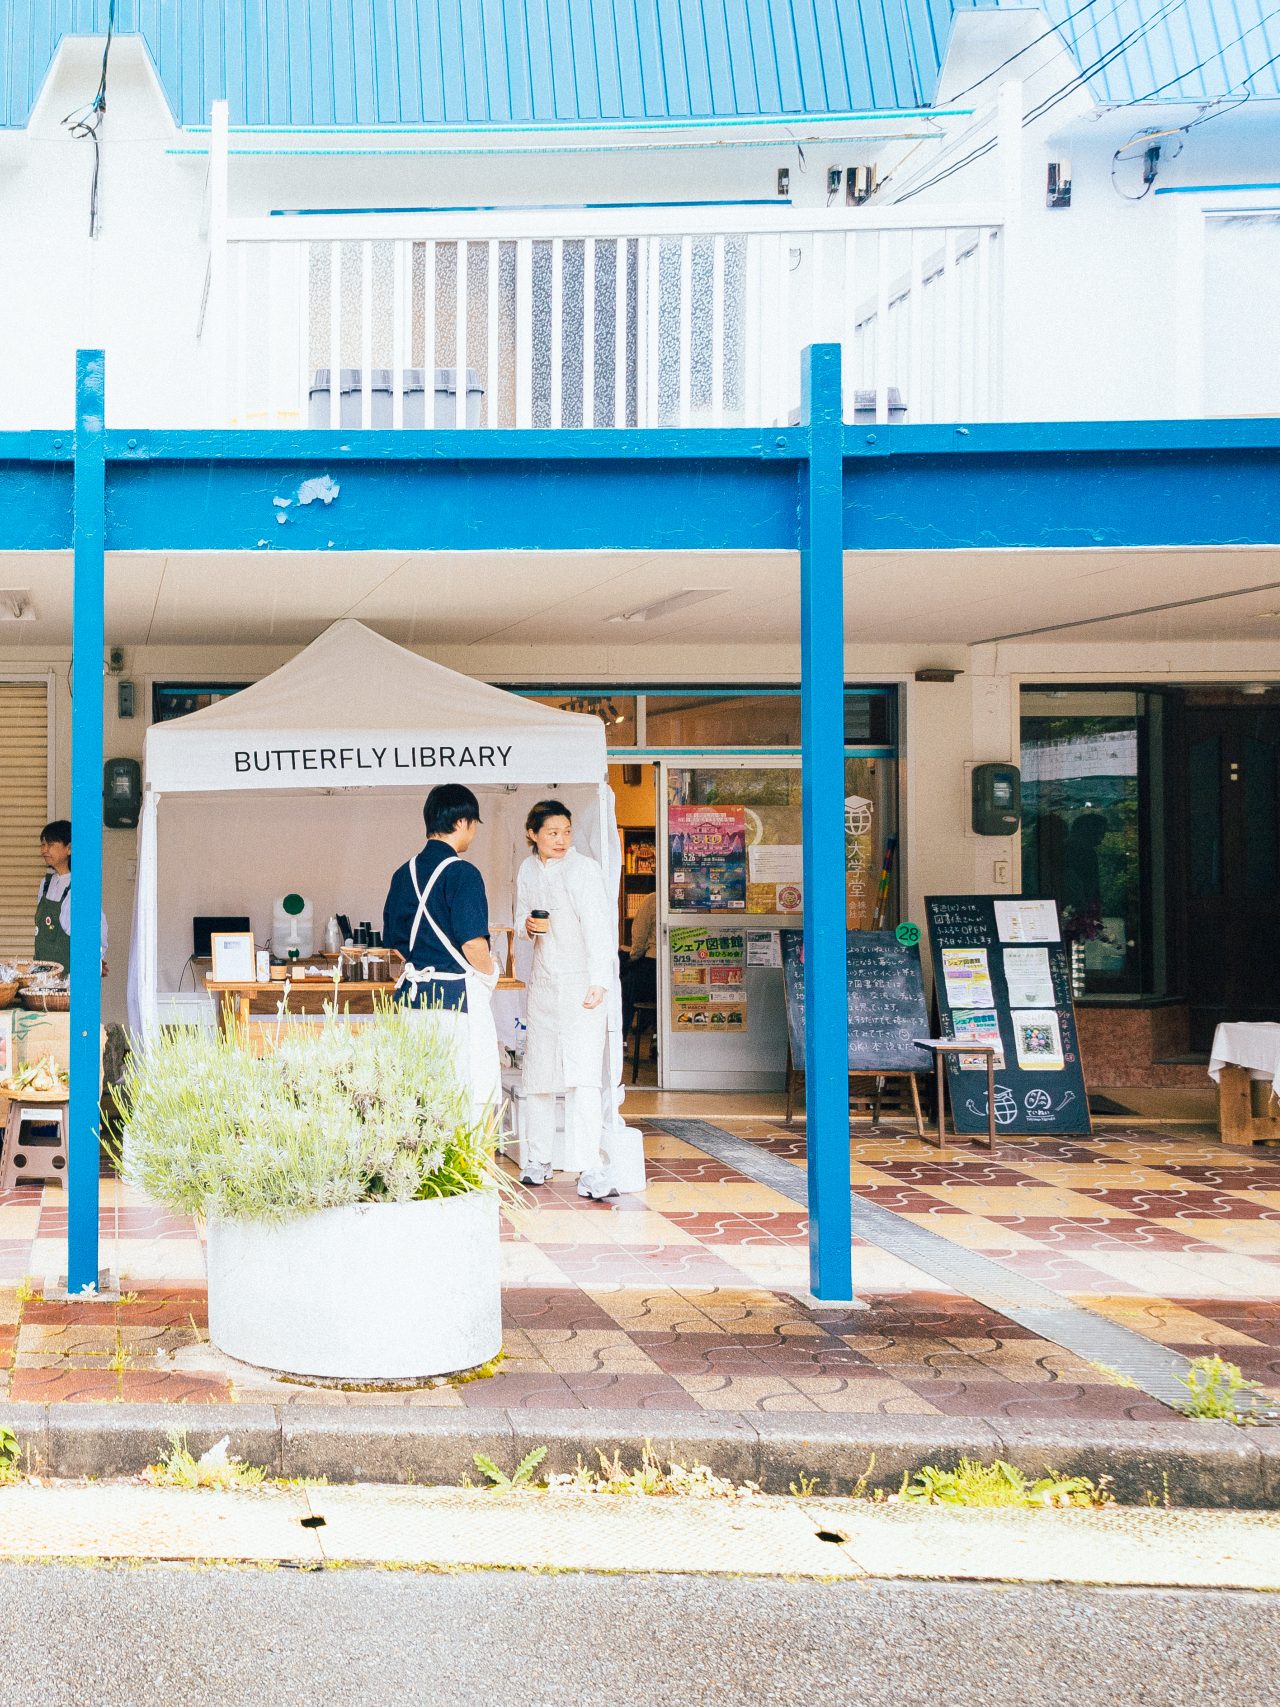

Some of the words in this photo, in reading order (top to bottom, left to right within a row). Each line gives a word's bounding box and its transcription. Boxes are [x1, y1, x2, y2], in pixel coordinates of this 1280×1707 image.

[235, 747, 387, 772] BUTTERFLY
[395, 745, 513, 768] LIBRARY
[847, 840, 866, 897] 大学堂
[898, 926, 919, 941] 28
[671, 935, 744, 953] シェア図書館
[673, 955, 691, 963] 5/19
